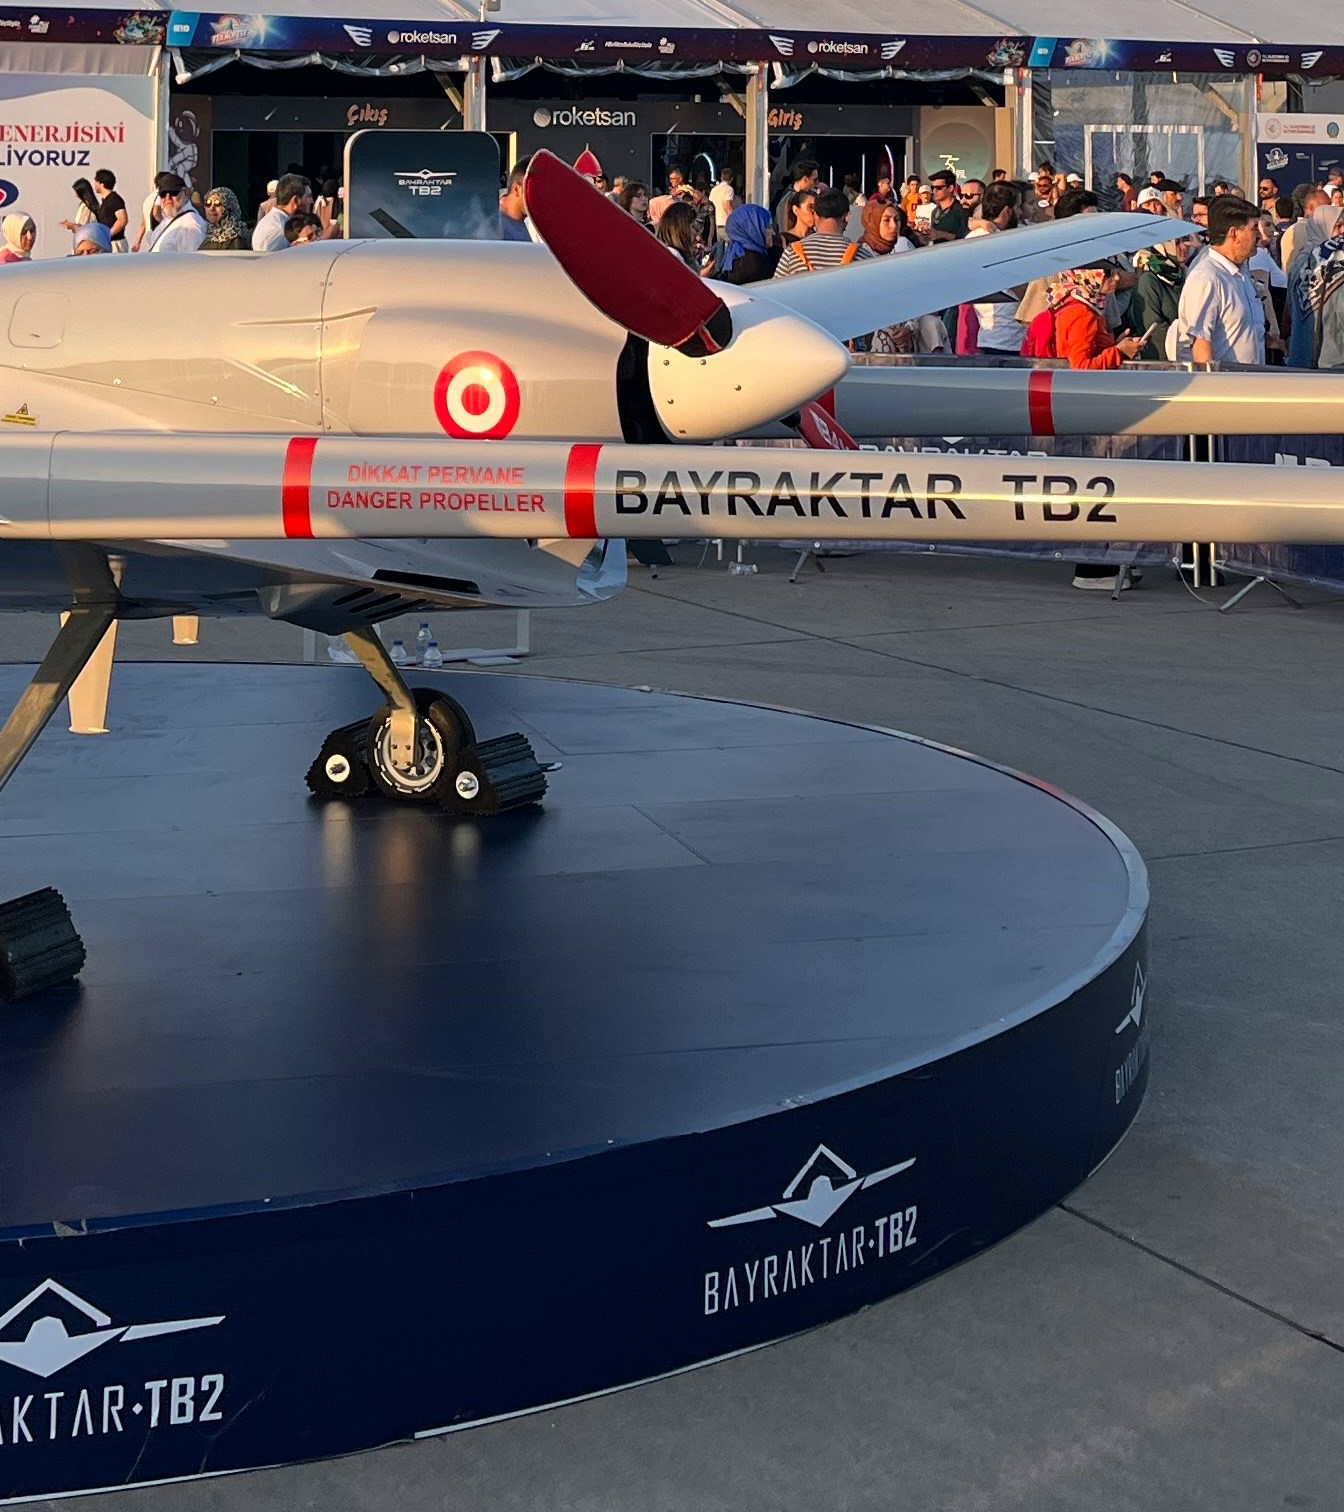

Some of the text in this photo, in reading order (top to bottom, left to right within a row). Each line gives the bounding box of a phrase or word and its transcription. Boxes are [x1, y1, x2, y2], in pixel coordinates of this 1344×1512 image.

[400, 29, 457, 45] roketsan
[818, 40, 869, 55] roketsan
[346, 103, 389, 127] Çıkış
[552, 106, 636, 127] roketsan
[767, 108, 803, 131] Giriş
[398, 178, 453, 186] BAYRAKTAR
[408, 185, 442, 196] TB2
[347, 461, 526, 486] DİKKAT PERVANE
[327, 489, 546, 513] DANGER PROPELLER
[614, 469, 1119, 524] BAYRAKTAR TB2
